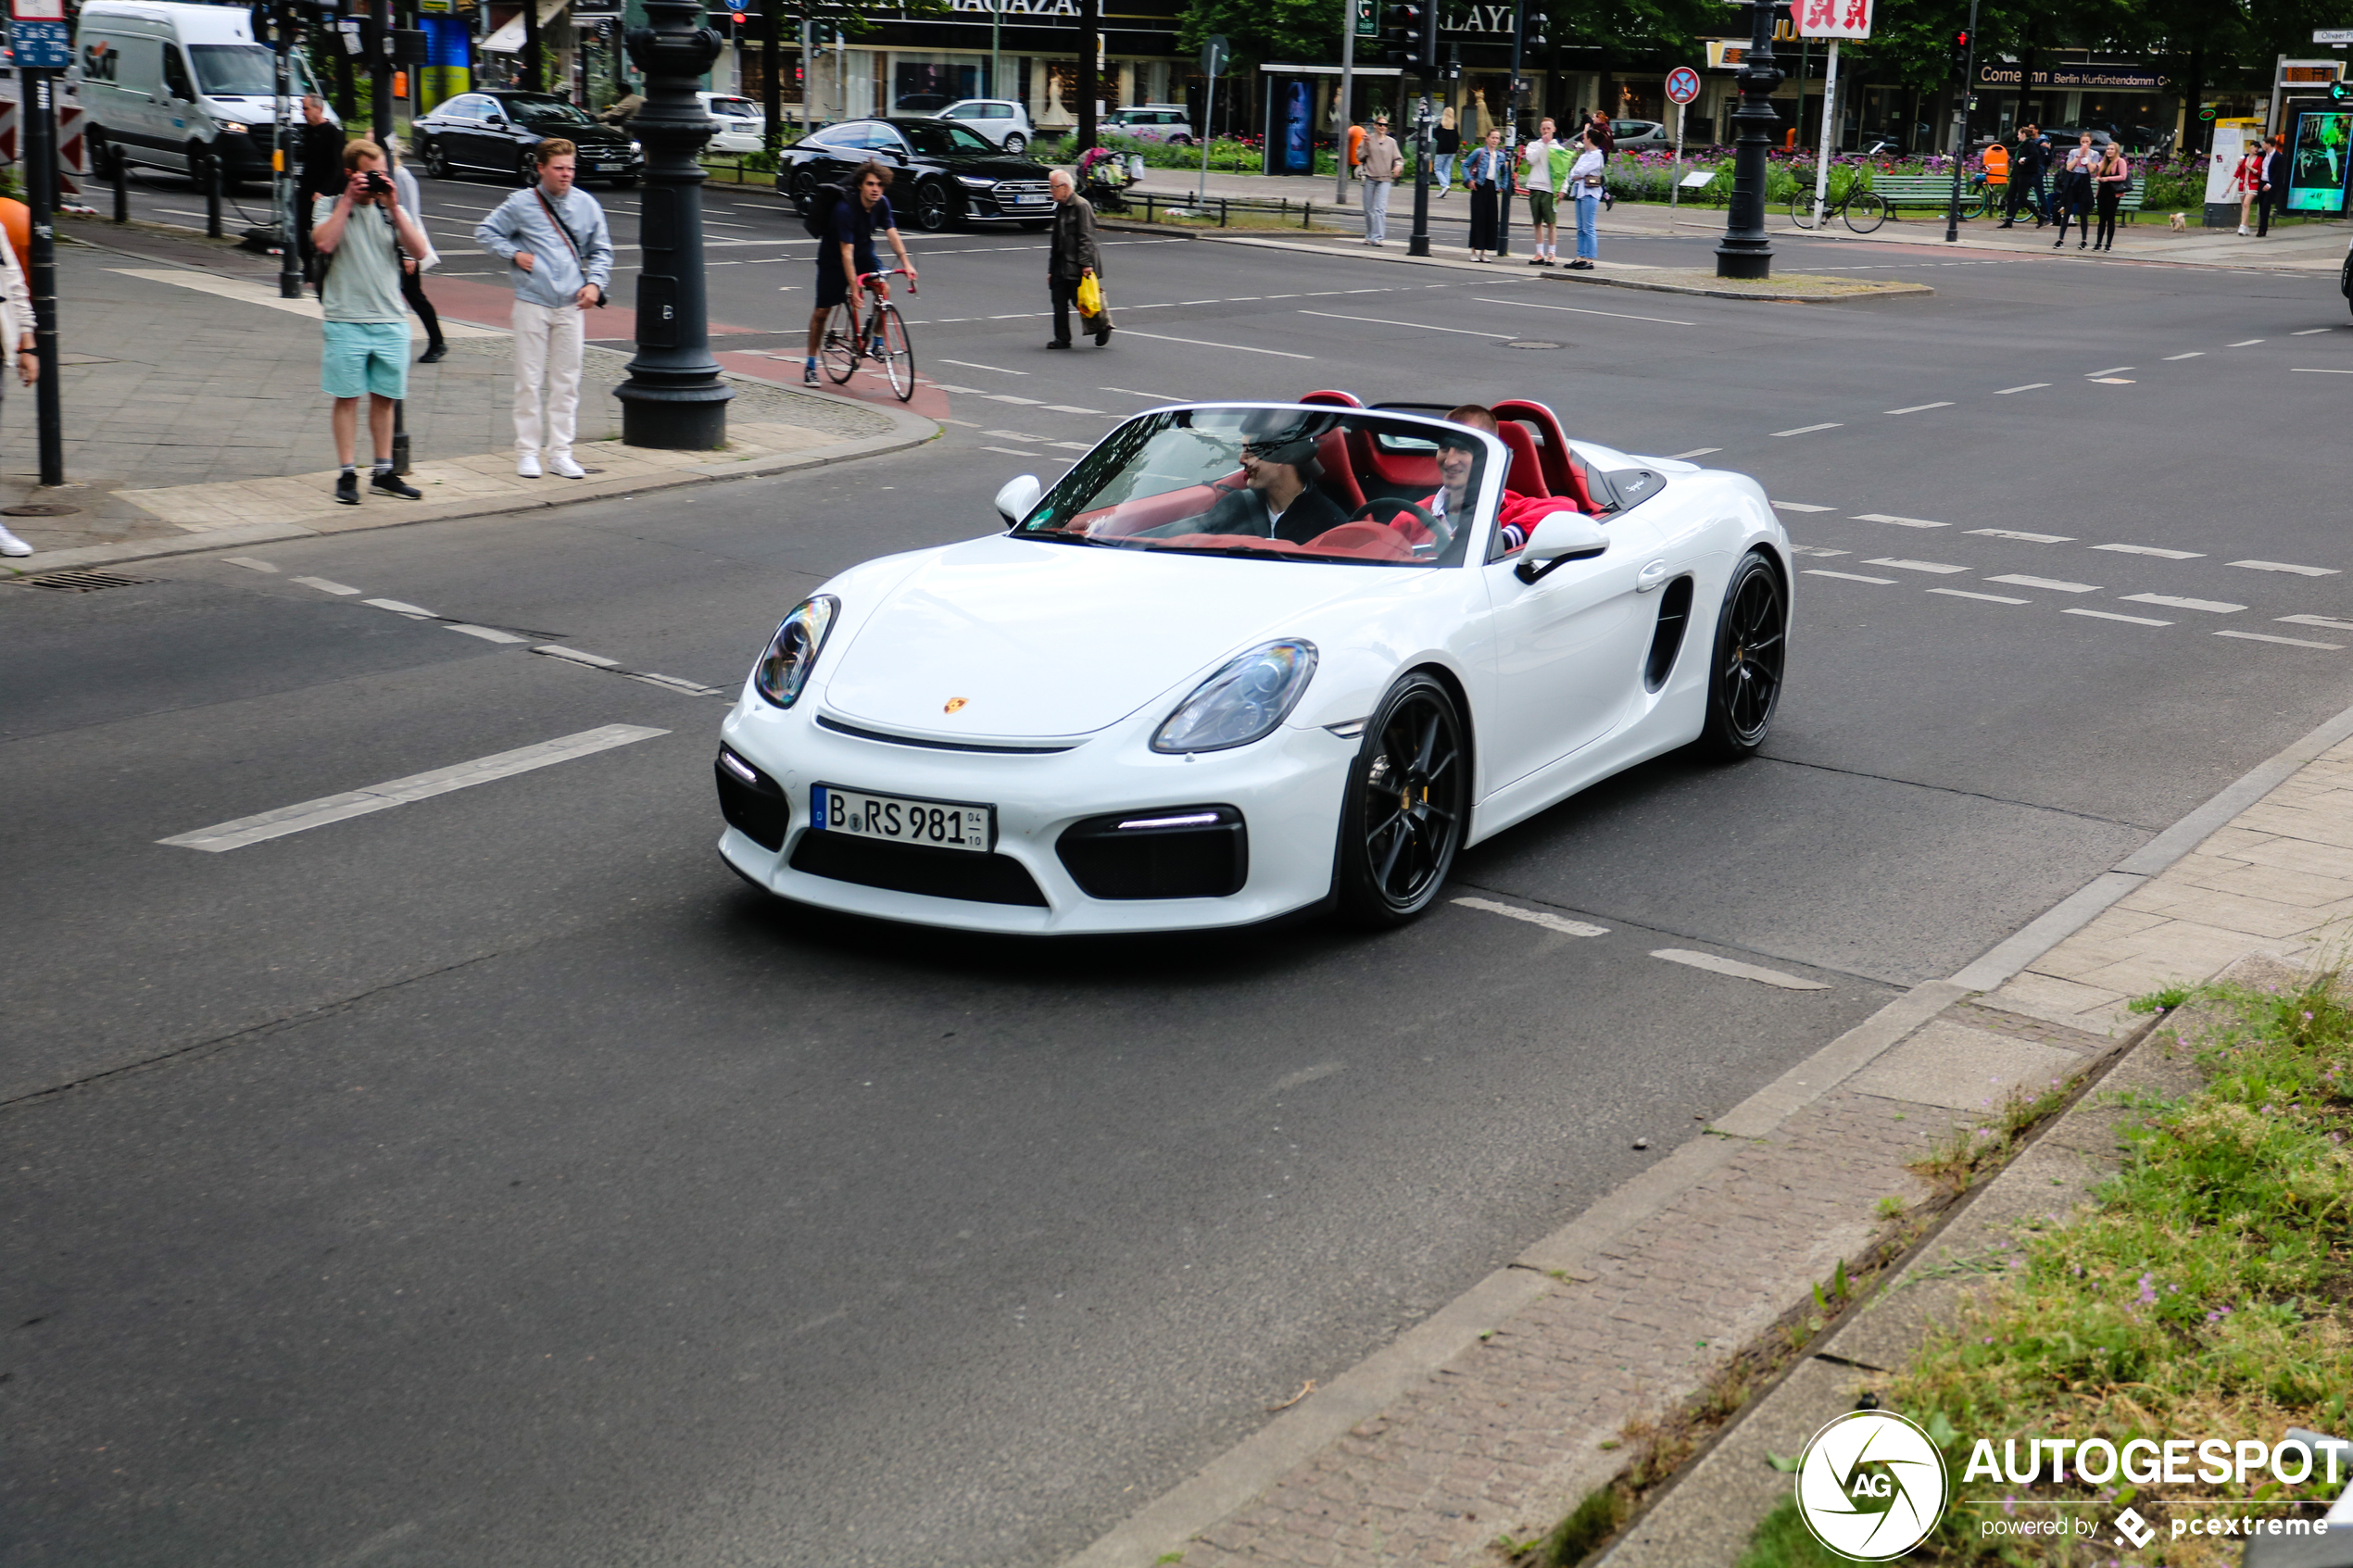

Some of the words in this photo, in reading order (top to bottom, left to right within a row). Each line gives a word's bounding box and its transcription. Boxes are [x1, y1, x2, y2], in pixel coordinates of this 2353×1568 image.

[2321, 31, 2345, 40] Olivaer
[1981, 66, 2021, 82] Come
[2054, 73, 2080, 83] Berlin
[2082, 74, 2155, 86] Kurfürstendamm
[816, 811, 823, 822] D
[831, 794, 846, 827] B
[865, 799, 901, 836] RS
[910, 806, 965, 845] 981
[968, 812, 981, 822] 04
[969, 835, 981, 846] 10
